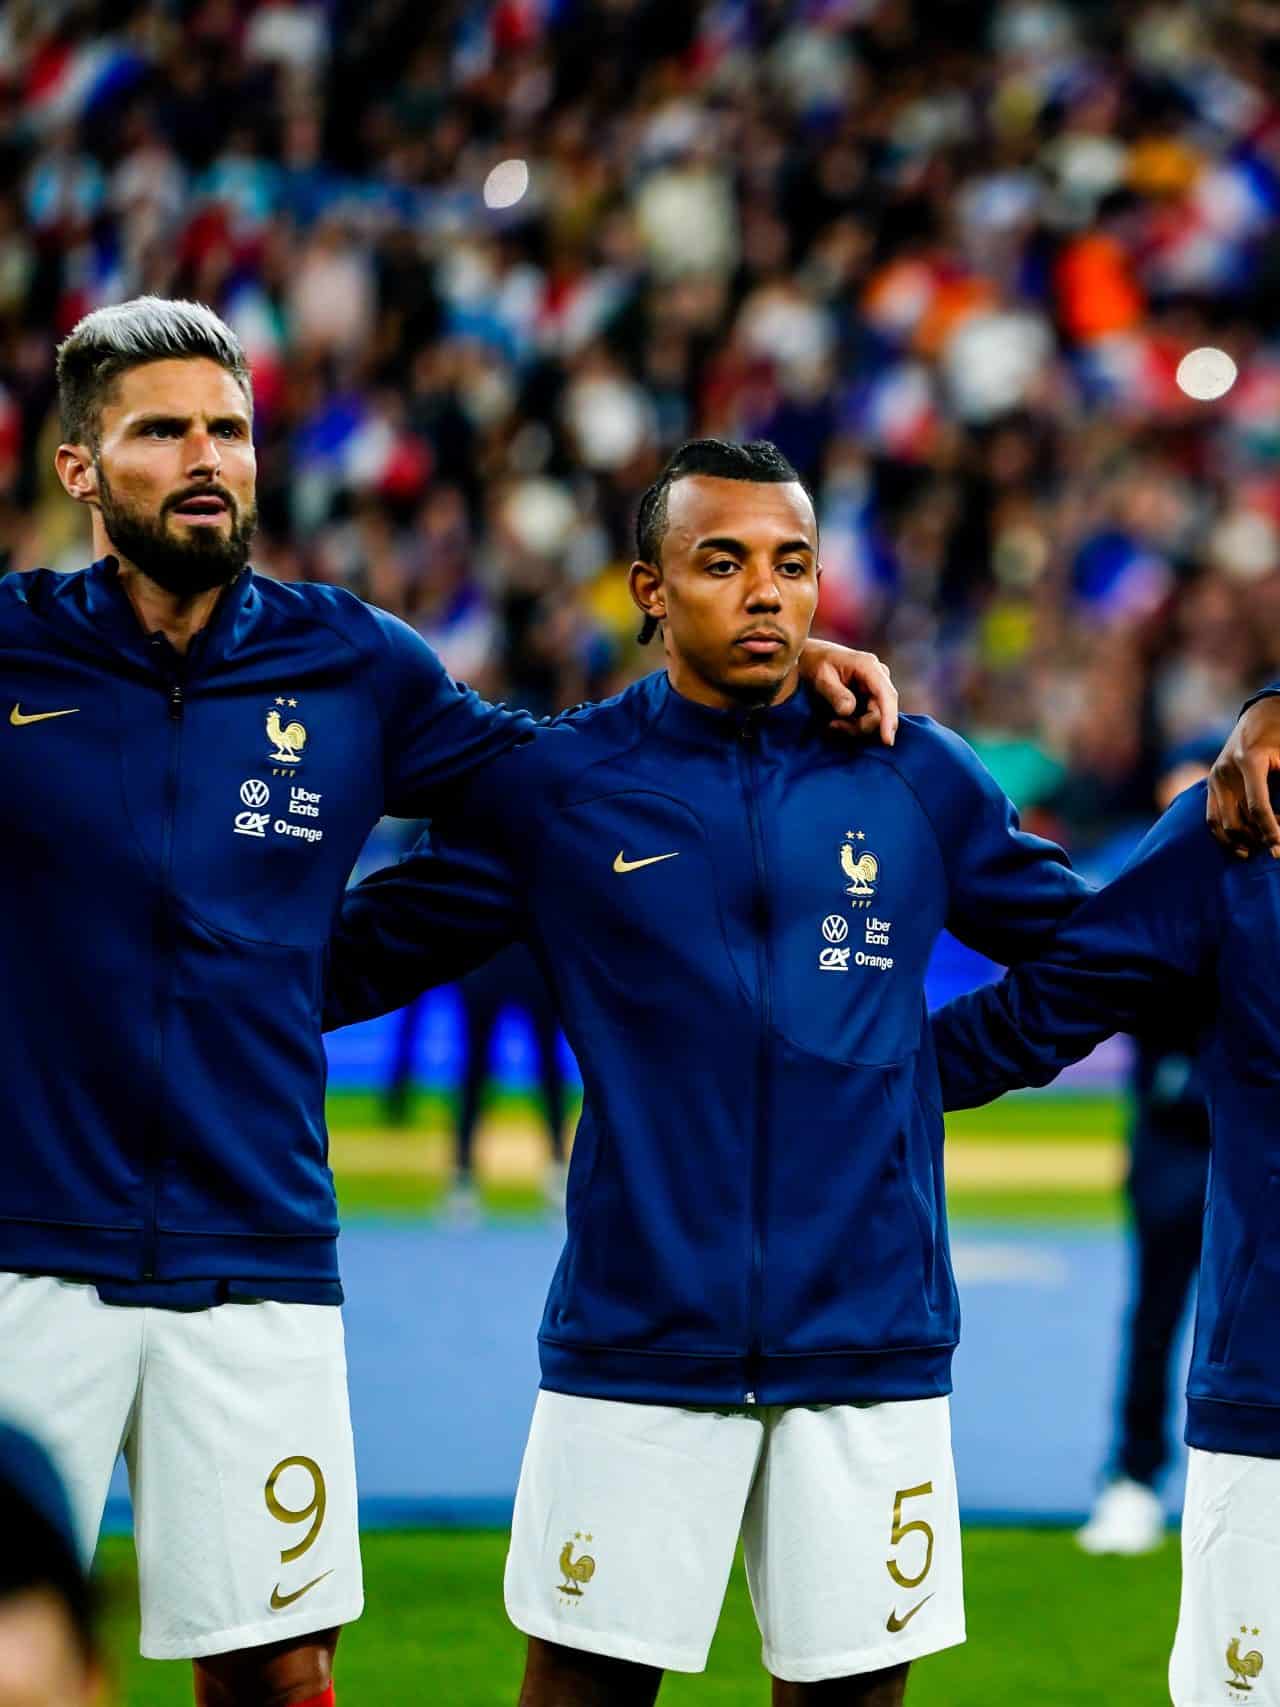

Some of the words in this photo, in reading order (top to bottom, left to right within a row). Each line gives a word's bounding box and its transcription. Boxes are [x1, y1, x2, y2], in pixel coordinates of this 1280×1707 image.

[240, 779, 270, 808] VW
[290, 786, 322, 803] Uber
[288, 800, 320, 817] Eats
[274, 820, 323, 842] Orange
[822, 914, 849, 943] VW
[866, 917, 891, 931] Uber
[865, 931, 889, 945] Eats
[855, 952, 894, 970] Orange
[264, 1455, 326, 1564] 9
[885, 1480, 934, 1588] 5
